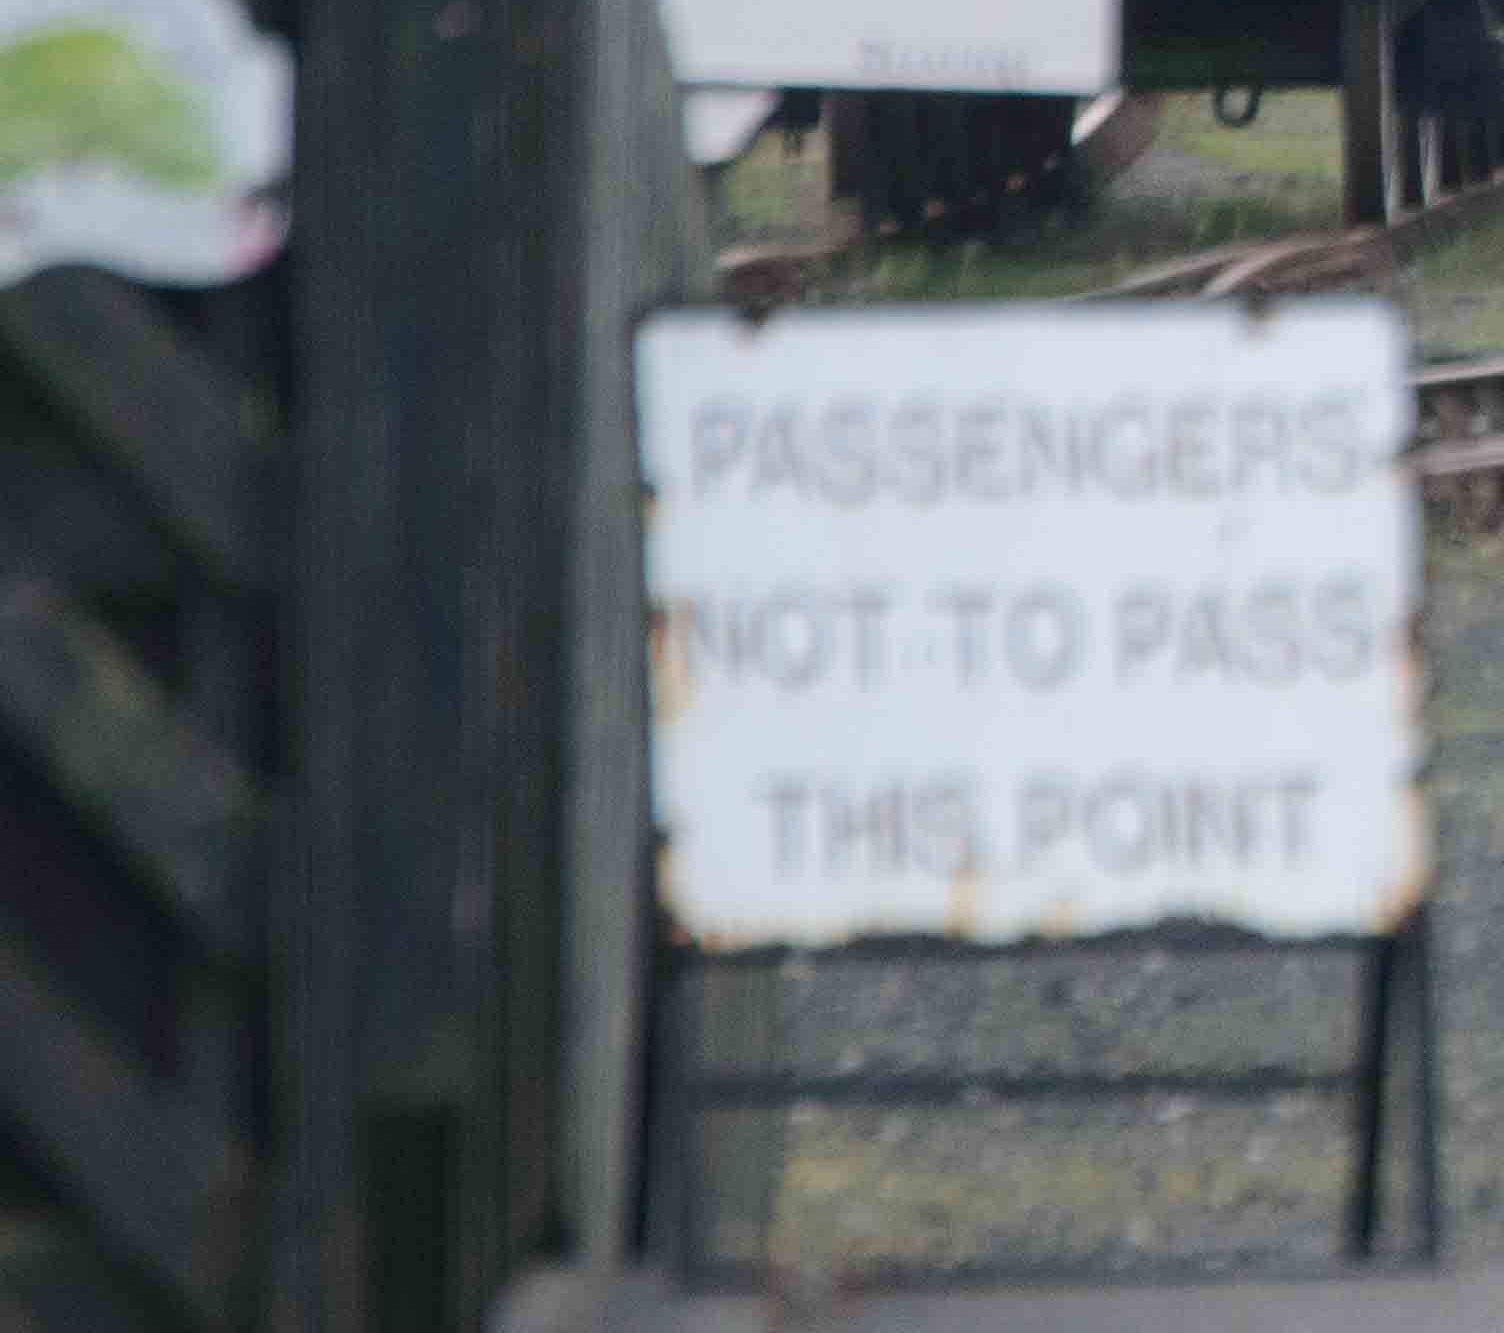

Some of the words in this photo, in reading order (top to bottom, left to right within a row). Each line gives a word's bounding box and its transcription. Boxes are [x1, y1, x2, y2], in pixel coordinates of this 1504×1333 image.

[692, 393, 1360, 508] PASSENGERS
[677, 583, 892, 698] NOT
[924, 583, 1085, 696] TO
[1115, 571, 1369, 690] PASS
[750, 767, 980, 883] THIS
[1017, 761, 1329, 874] POINT
